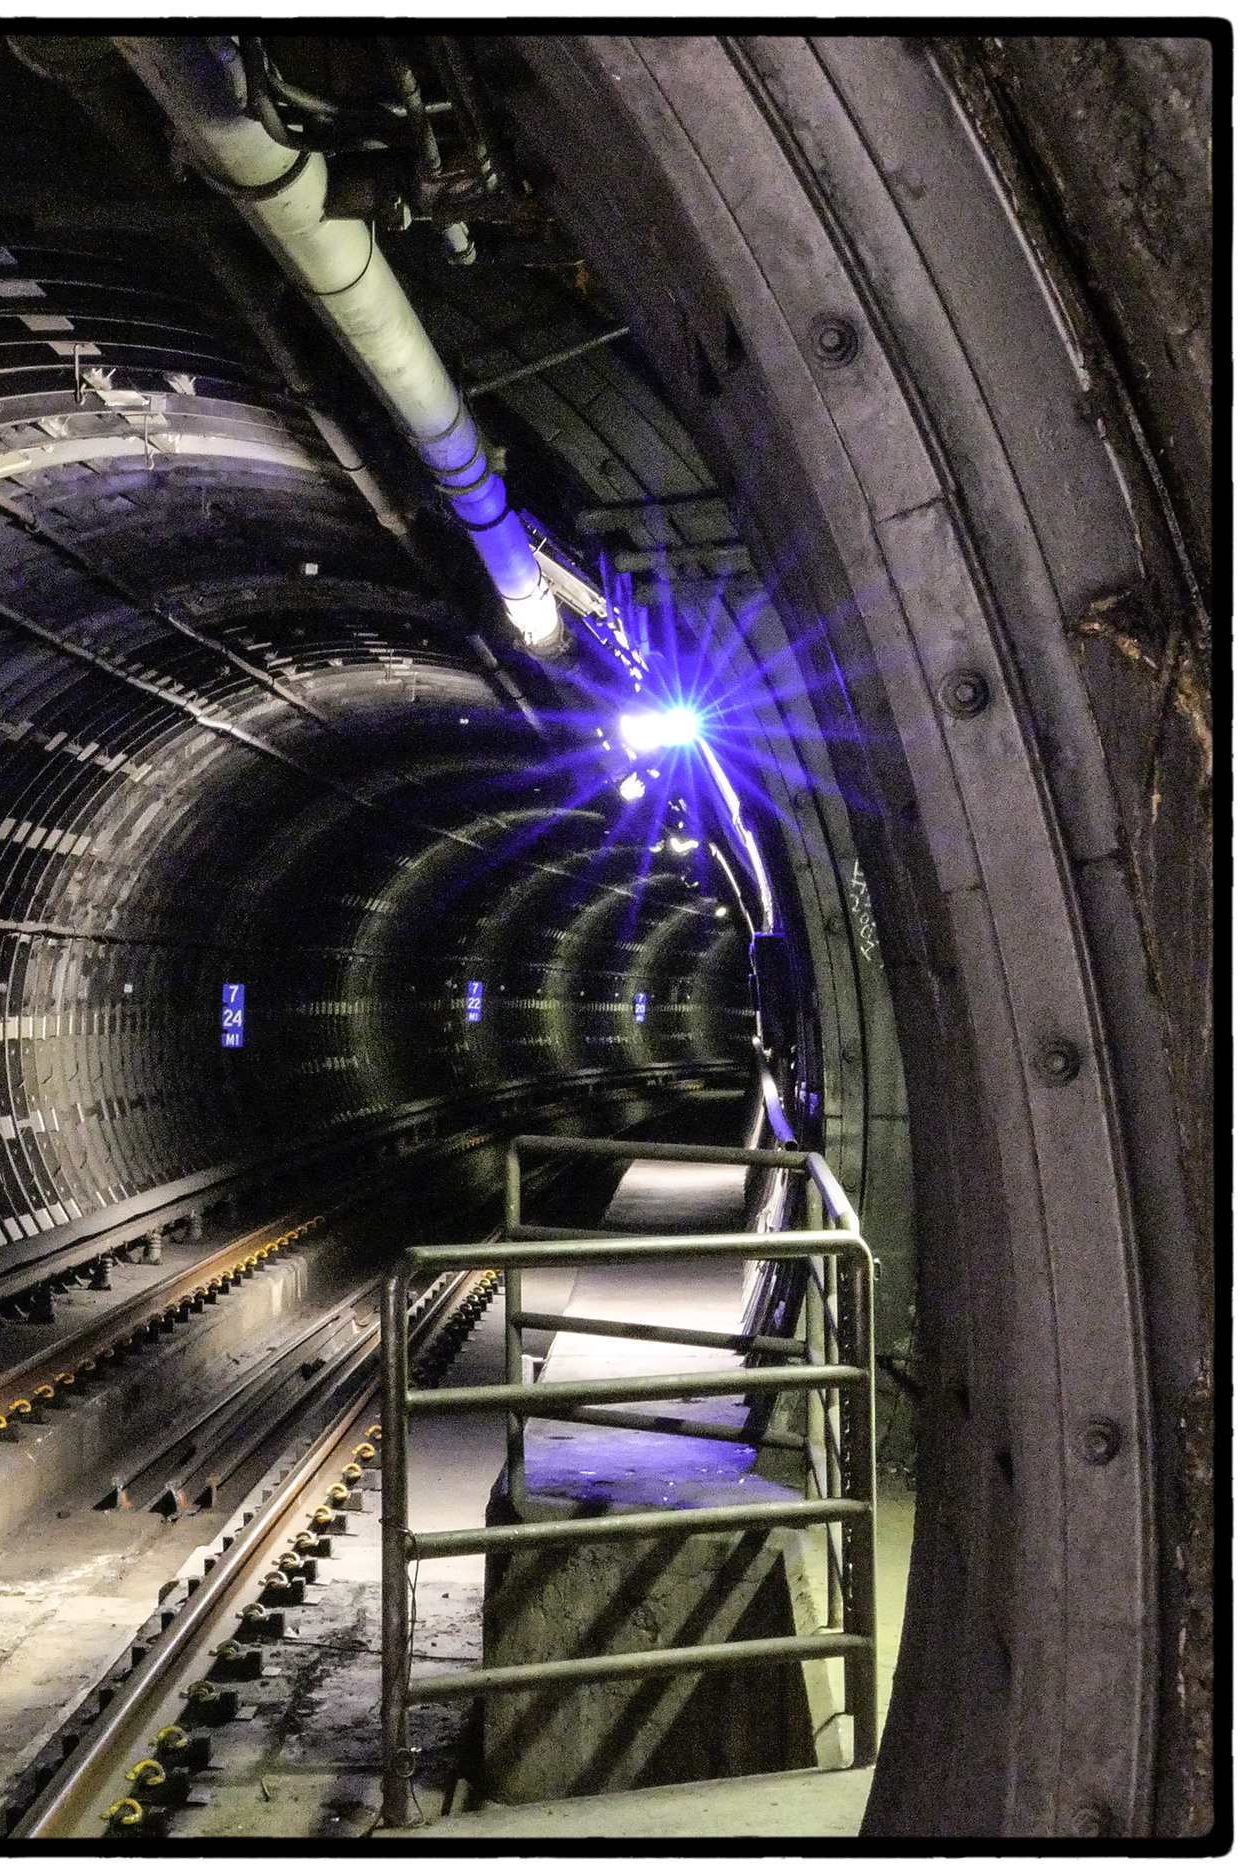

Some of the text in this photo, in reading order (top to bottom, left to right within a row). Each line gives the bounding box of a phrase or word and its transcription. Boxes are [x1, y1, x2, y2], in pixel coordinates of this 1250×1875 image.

[229, 984, 239, 1003] 7
[472, 982, 479, 994] 7
[467, 997, 481, 1009] 22
[223, 1008, 243, 1027] 24
